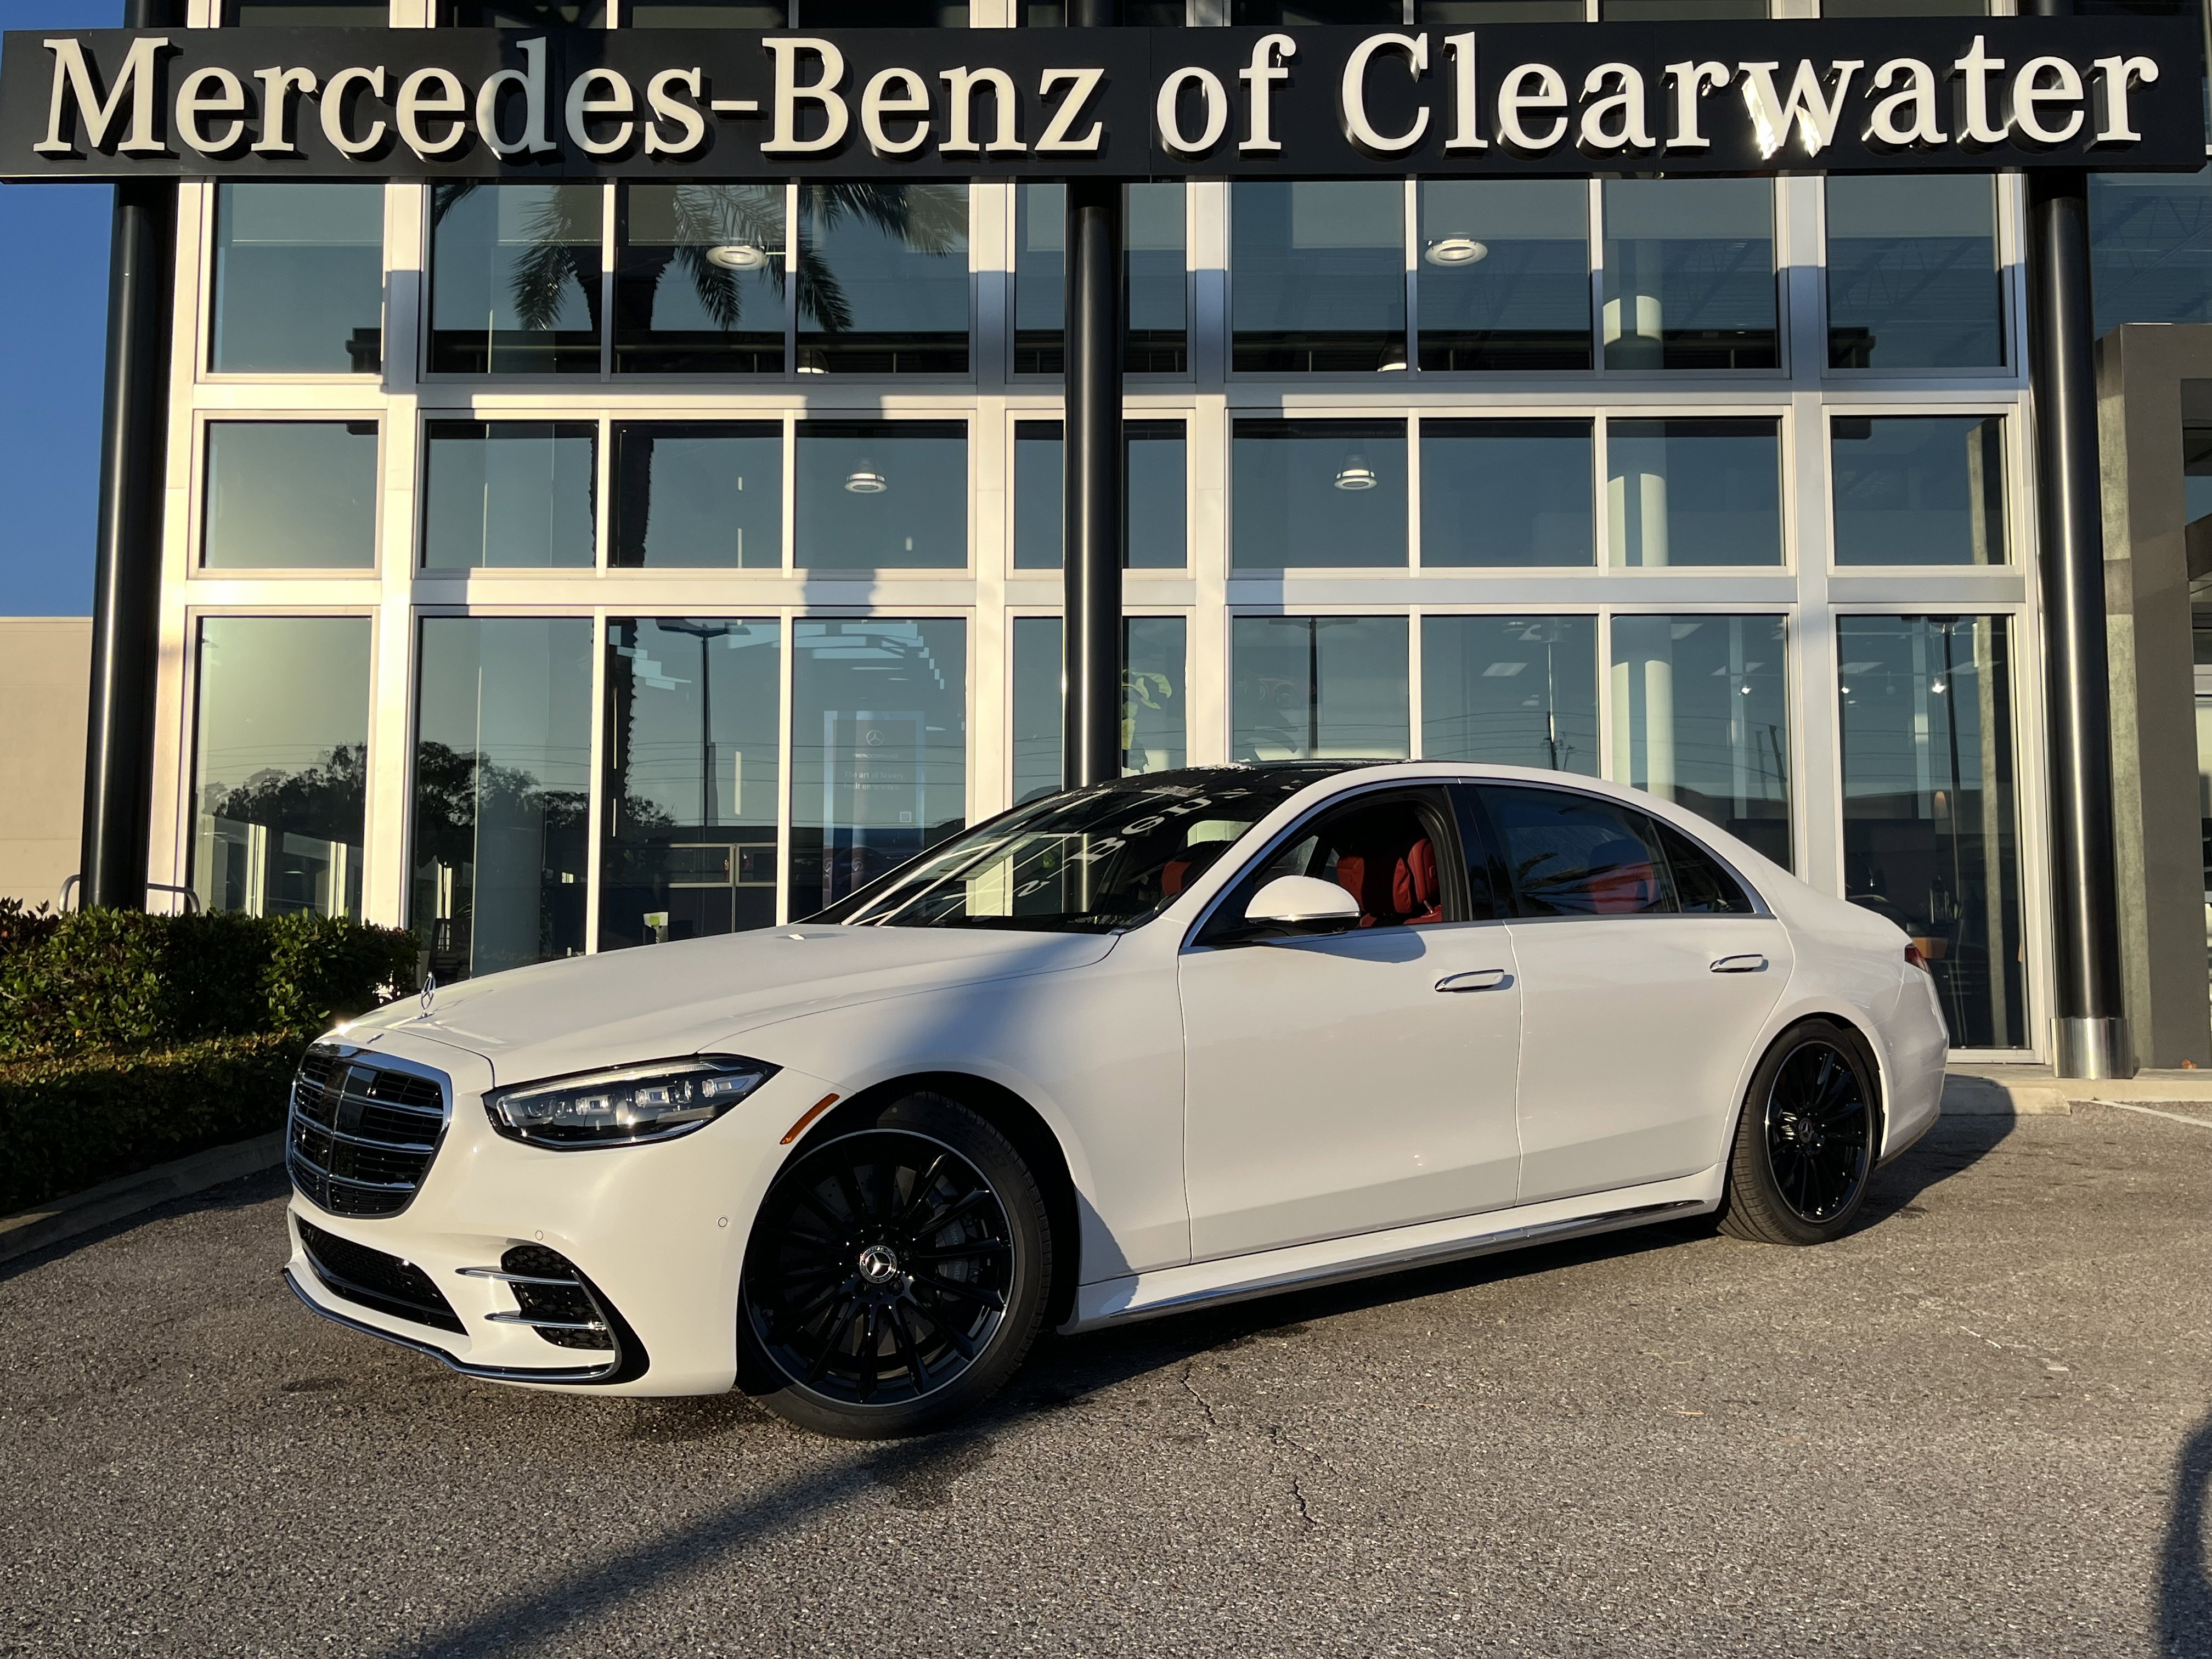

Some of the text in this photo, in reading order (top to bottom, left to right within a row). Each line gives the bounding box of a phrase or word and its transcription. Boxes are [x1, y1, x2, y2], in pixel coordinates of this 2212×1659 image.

[33, 31, 2159, 155] Mercedes-Benz of Clearwater
[844, 782, 860, 790] built
